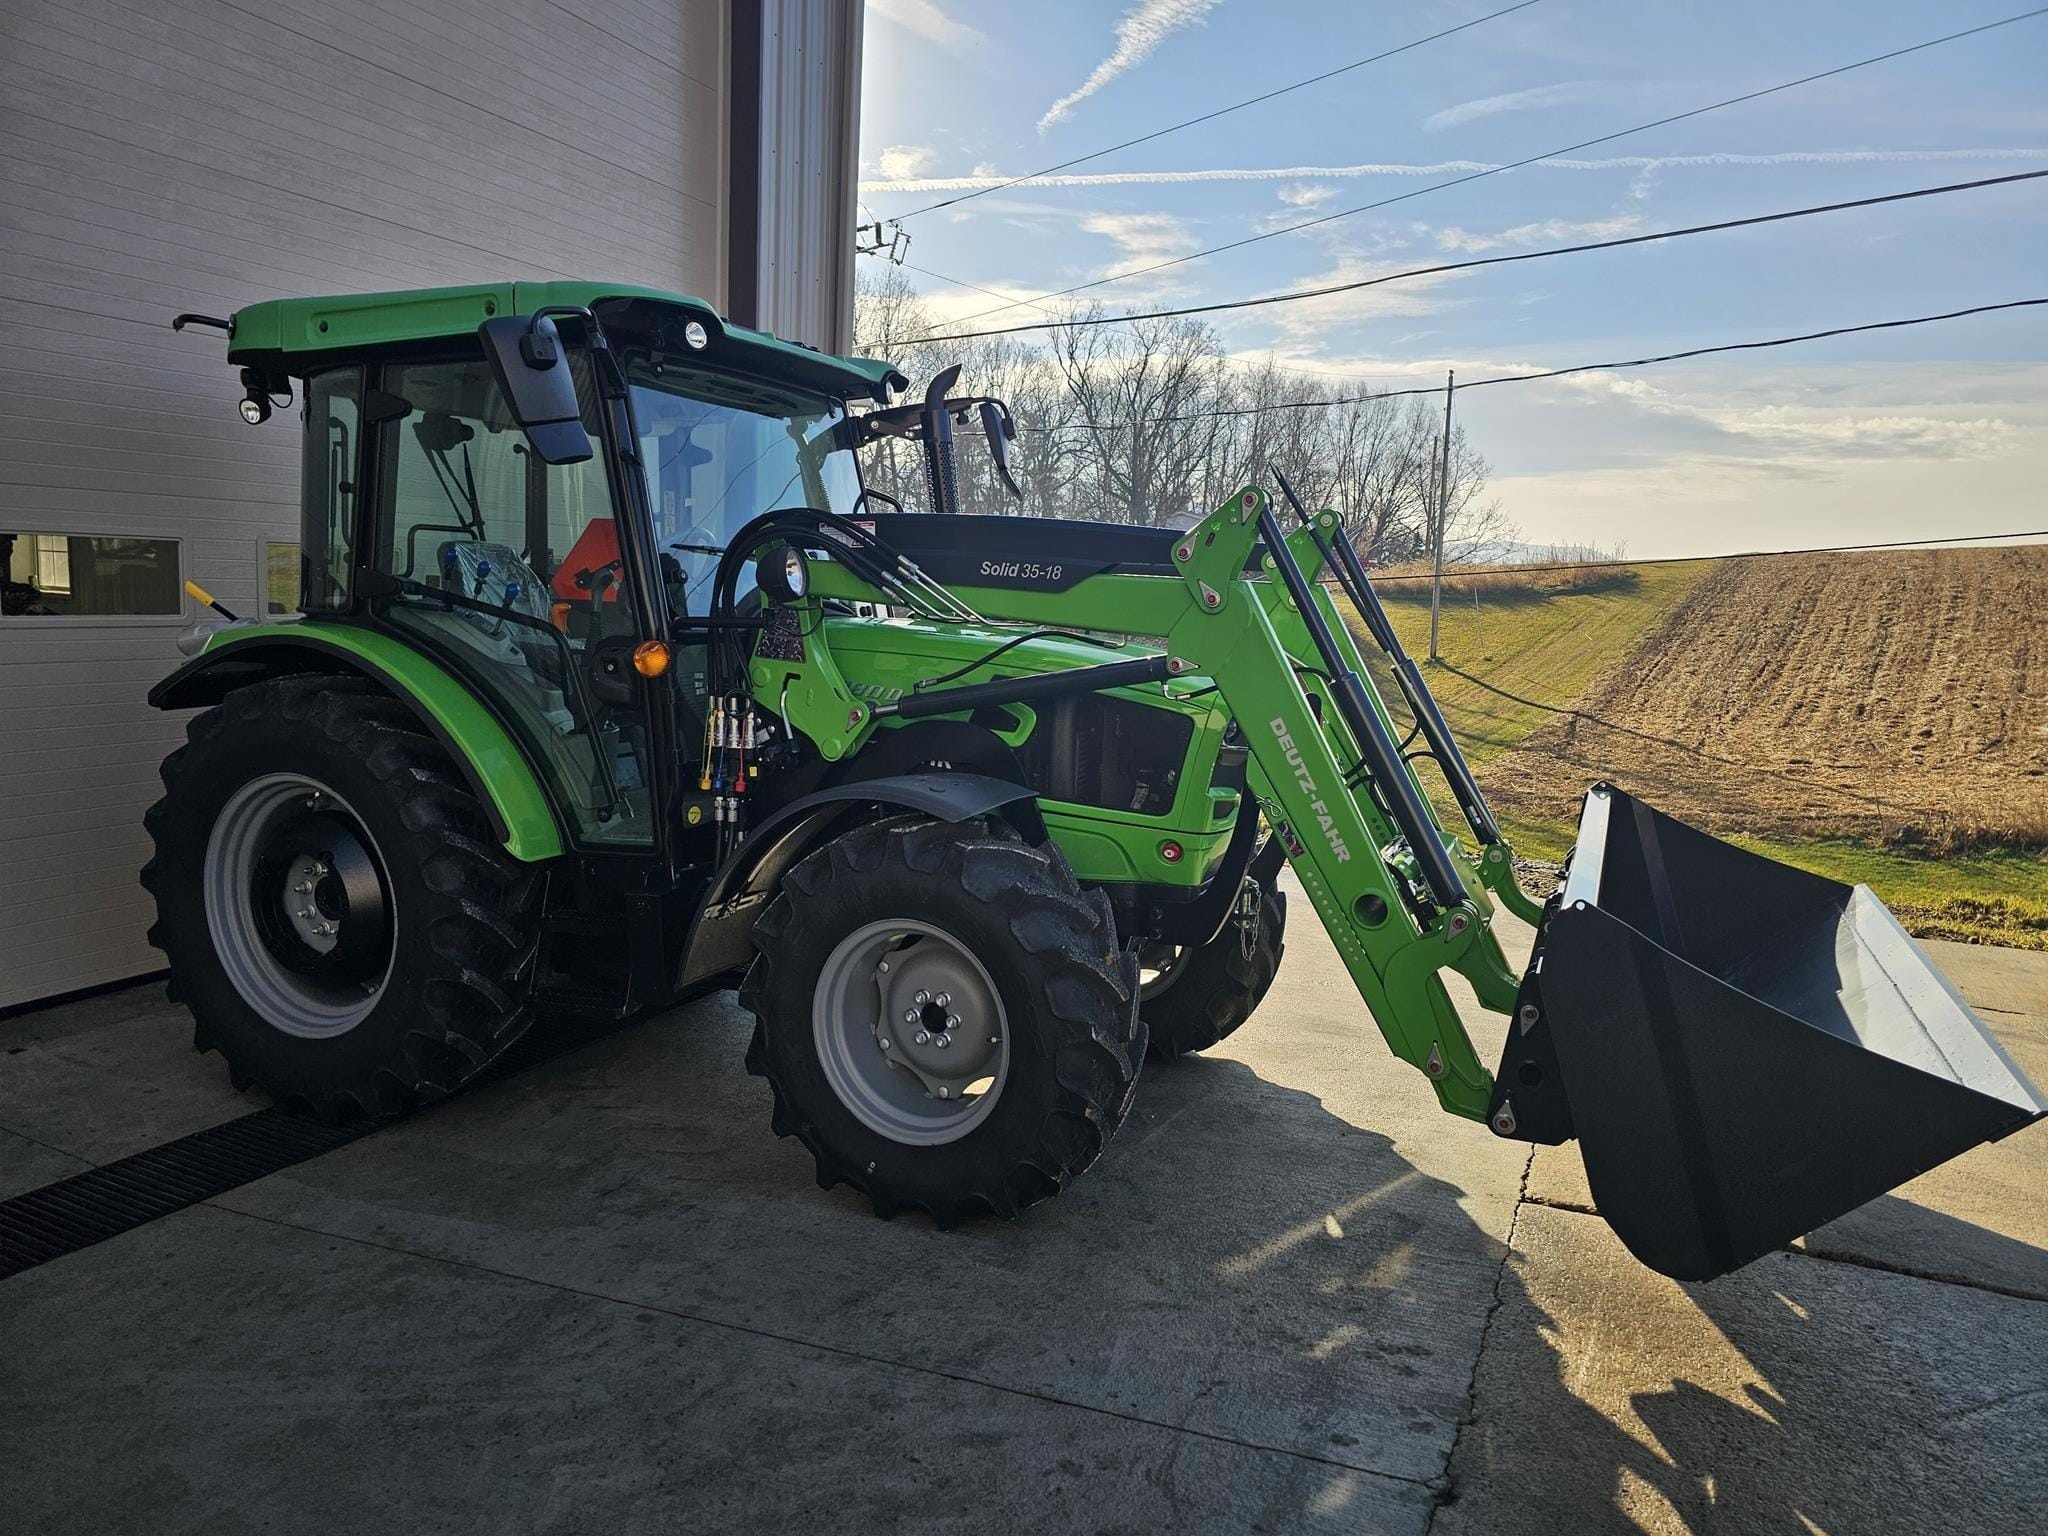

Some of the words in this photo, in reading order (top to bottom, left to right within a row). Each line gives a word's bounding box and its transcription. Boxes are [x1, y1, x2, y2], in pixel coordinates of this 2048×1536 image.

[980, 561, 1020, 577] Solid
[1021, 563, 1062, 580] 35-18
[1269, 716, 1351, 864] DEUTZ-FAHR
